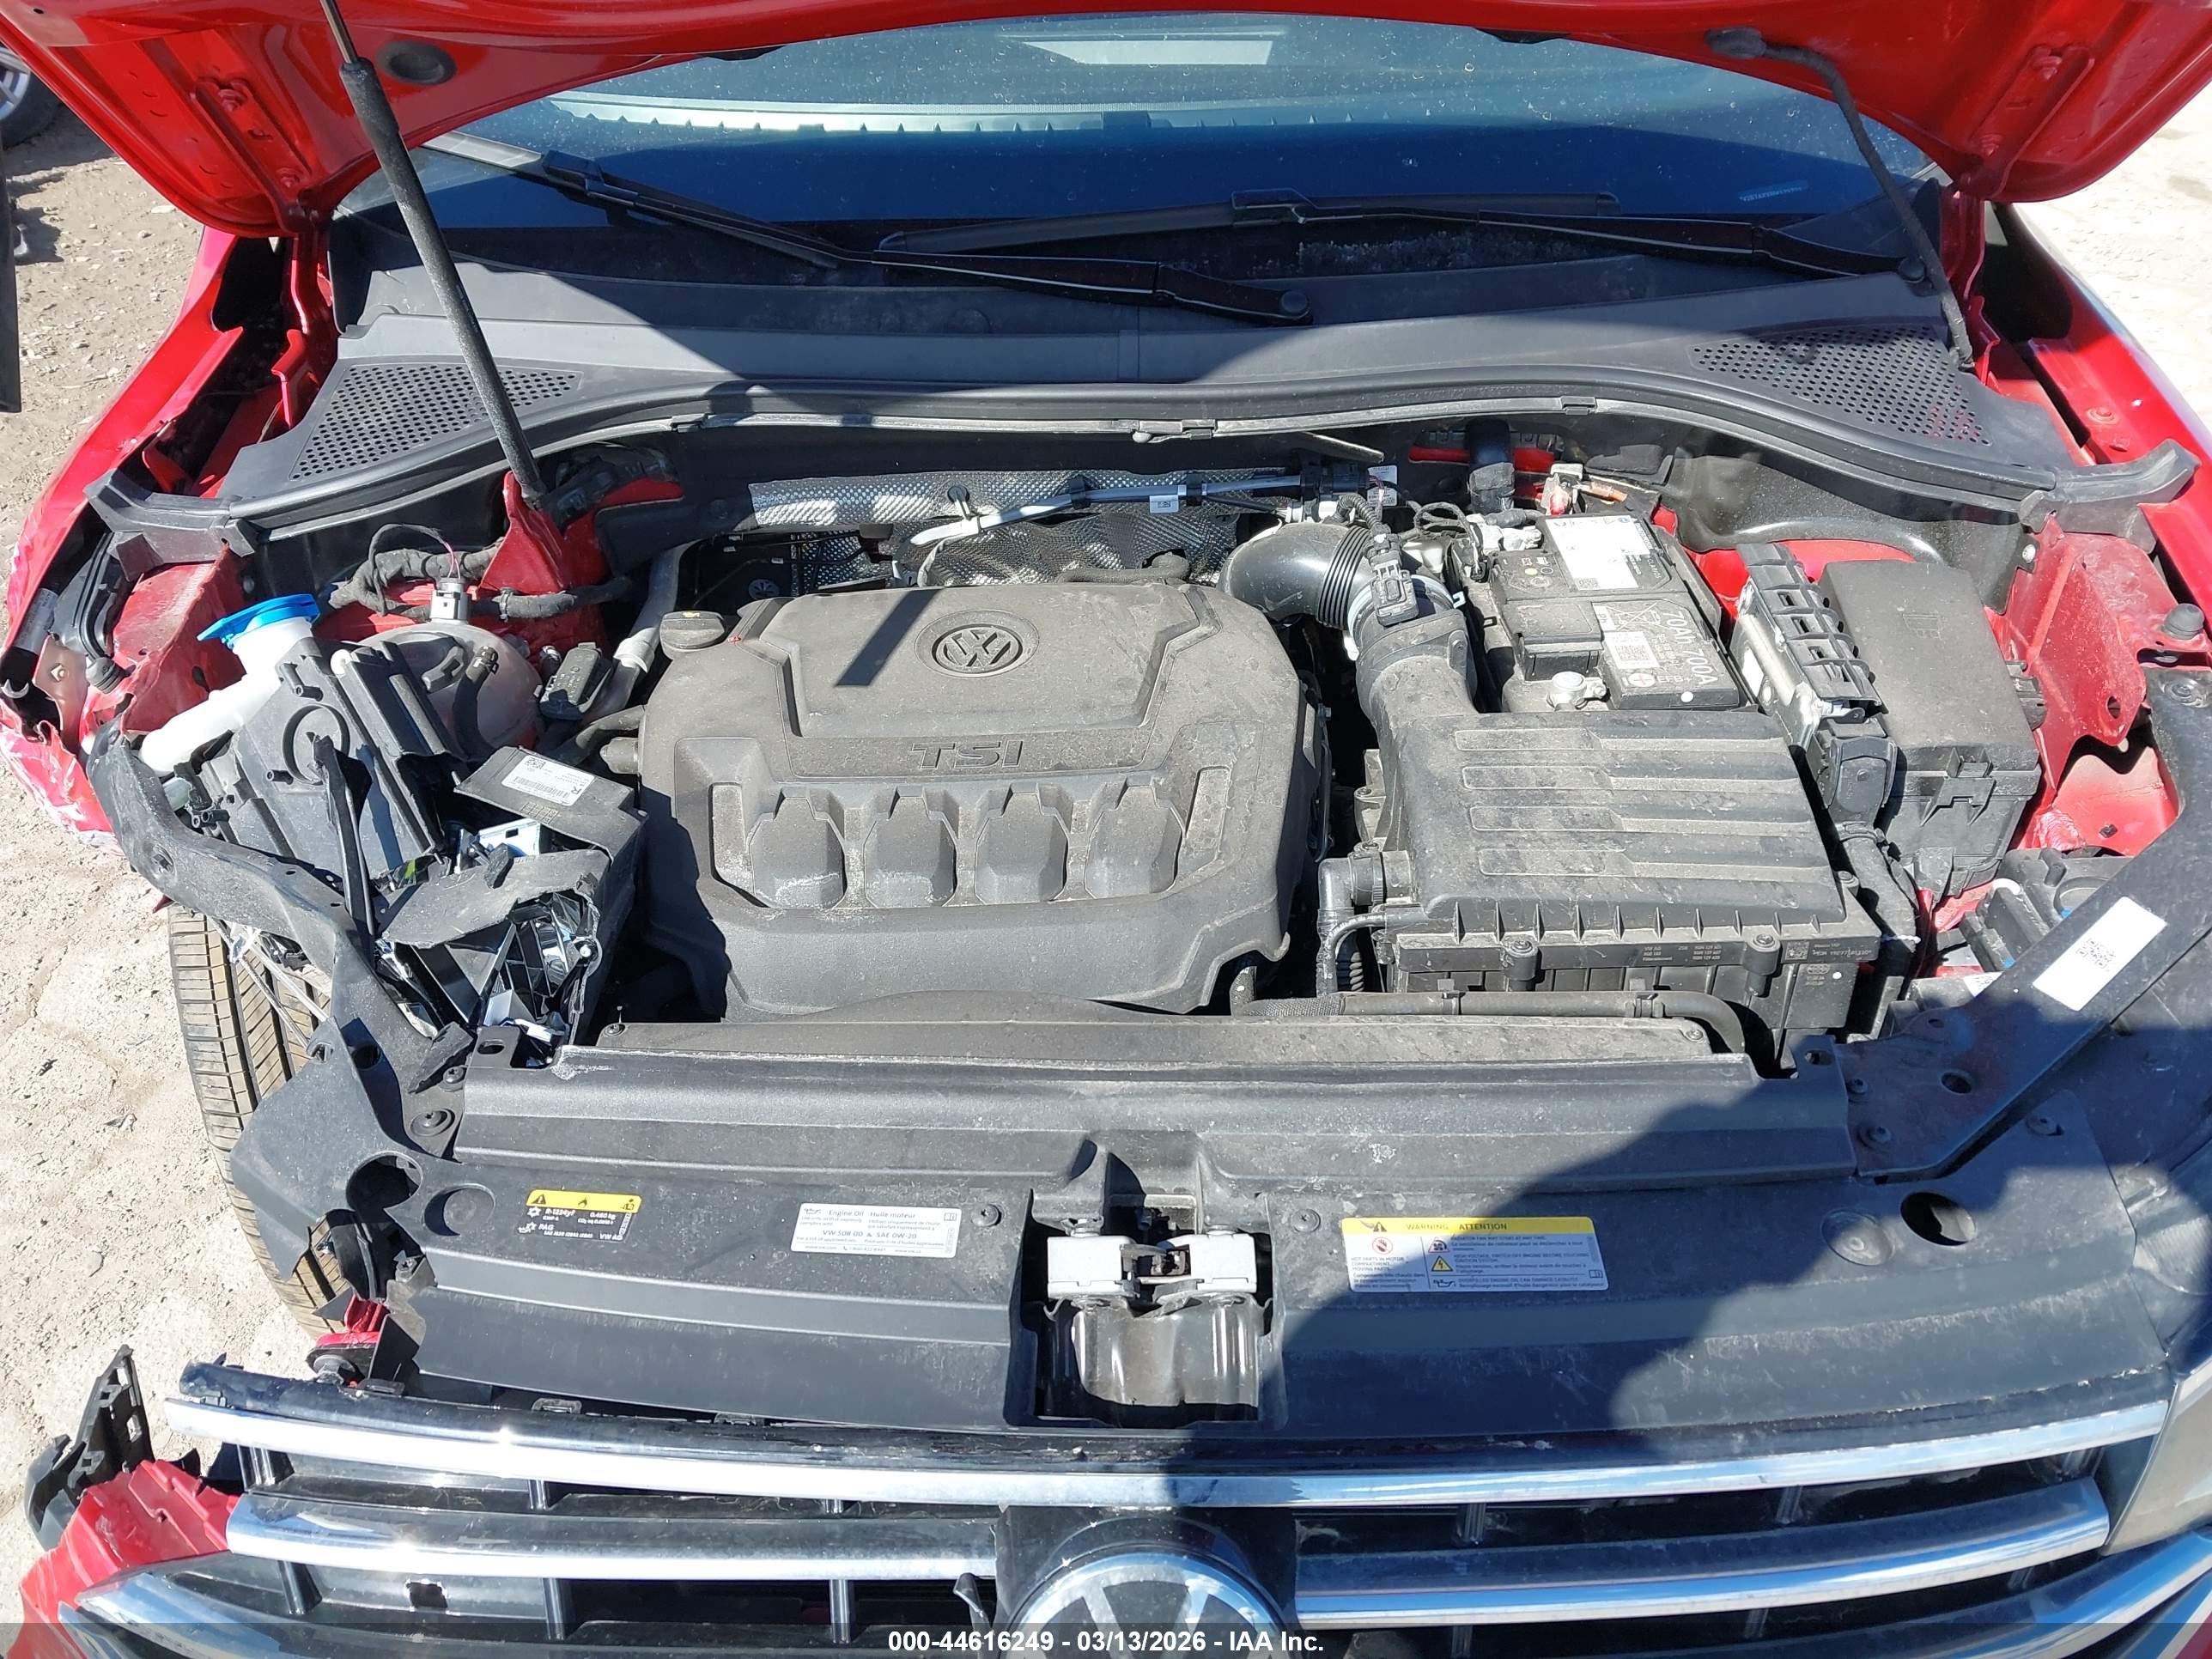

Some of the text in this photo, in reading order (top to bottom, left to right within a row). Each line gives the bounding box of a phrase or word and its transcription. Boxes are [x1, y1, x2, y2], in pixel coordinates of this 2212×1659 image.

[1662, 611, 1698, 646] 70Ah
[1685, 648, 1718, 686] 700A
[1656, 674, 1691, 684] EFB+
[911, 739, 1024, 770] TSI
[544, 1208, 576, 1218] R-1234yf
[829, 1209, 853, 1218] Engine
[1458, 1222, 1508, 1231] ATTENTION
